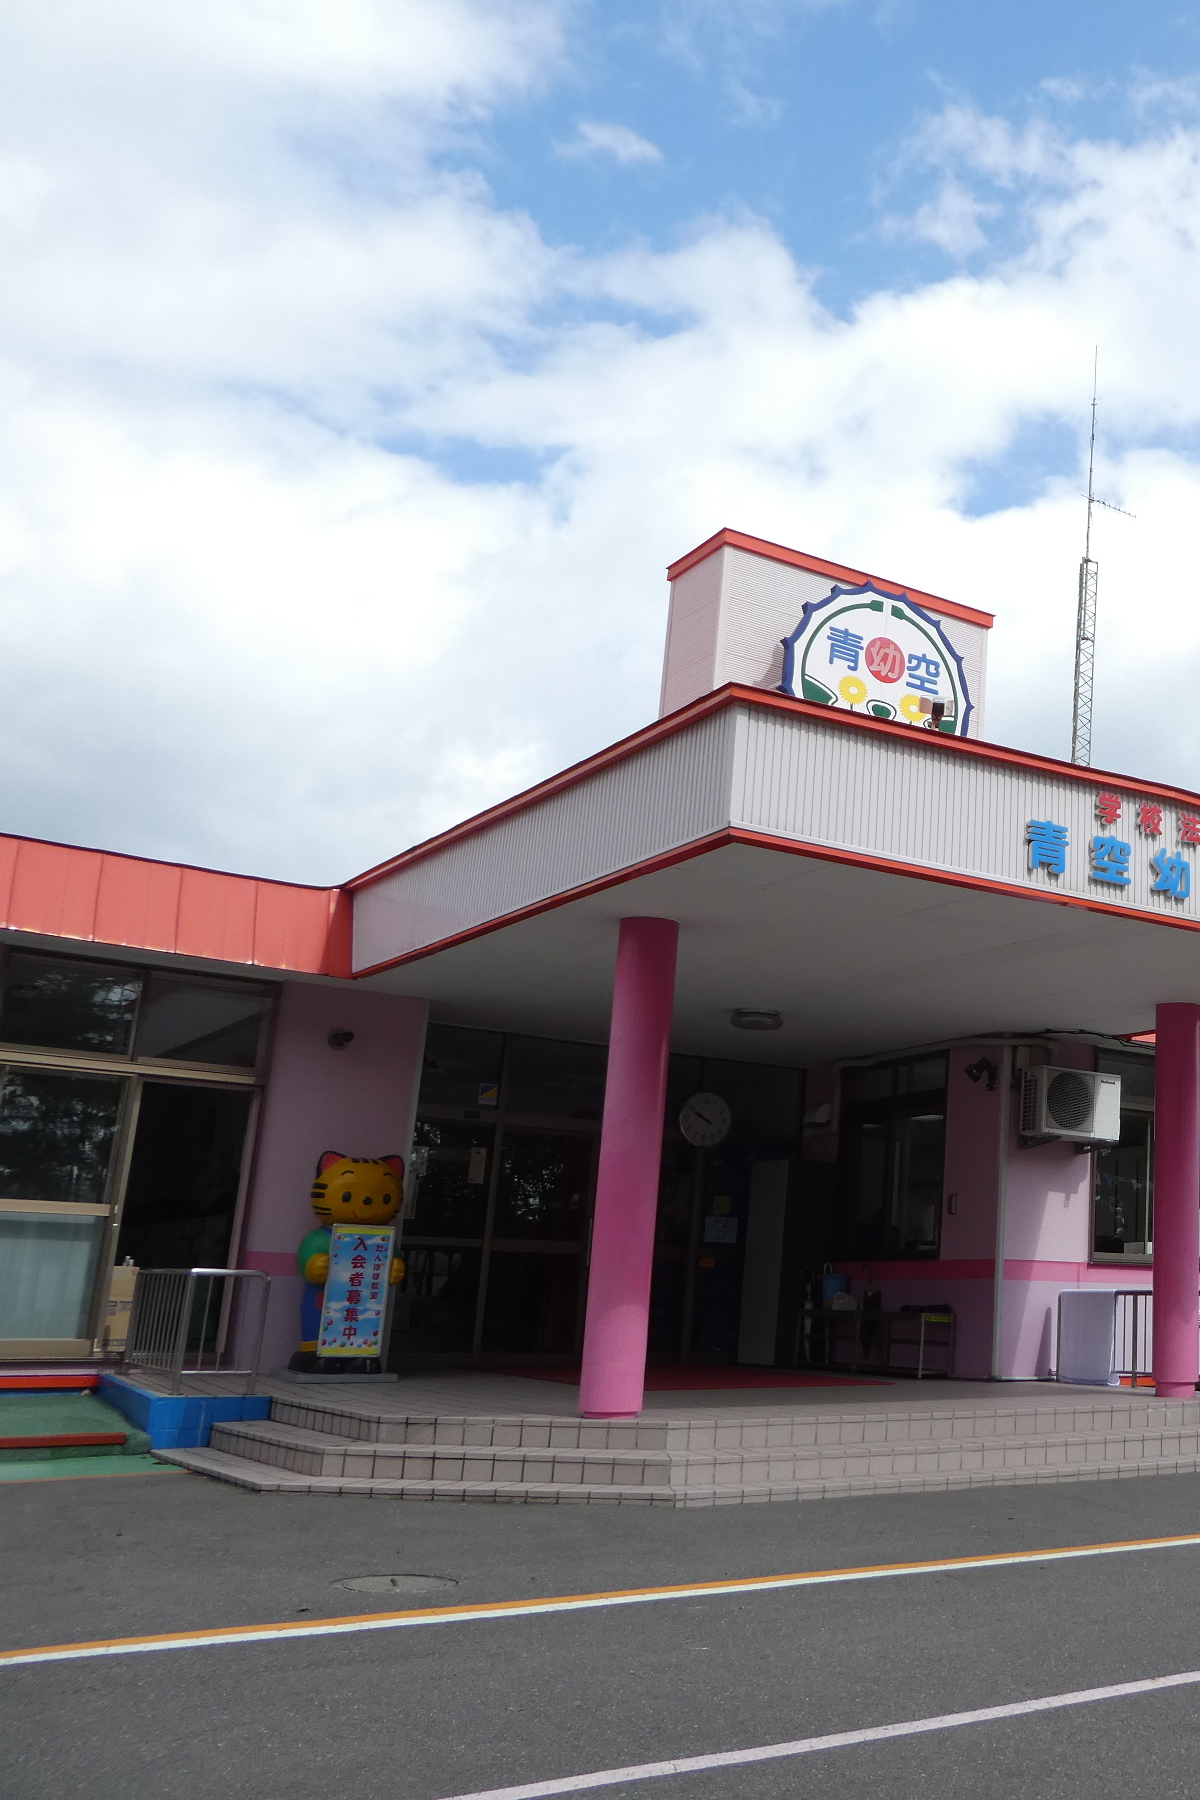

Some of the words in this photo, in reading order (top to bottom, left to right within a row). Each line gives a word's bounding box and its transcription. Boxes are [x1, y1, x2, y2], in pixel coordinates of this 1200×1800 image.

[342, 1237, 368, 1341] 入会者募集中
